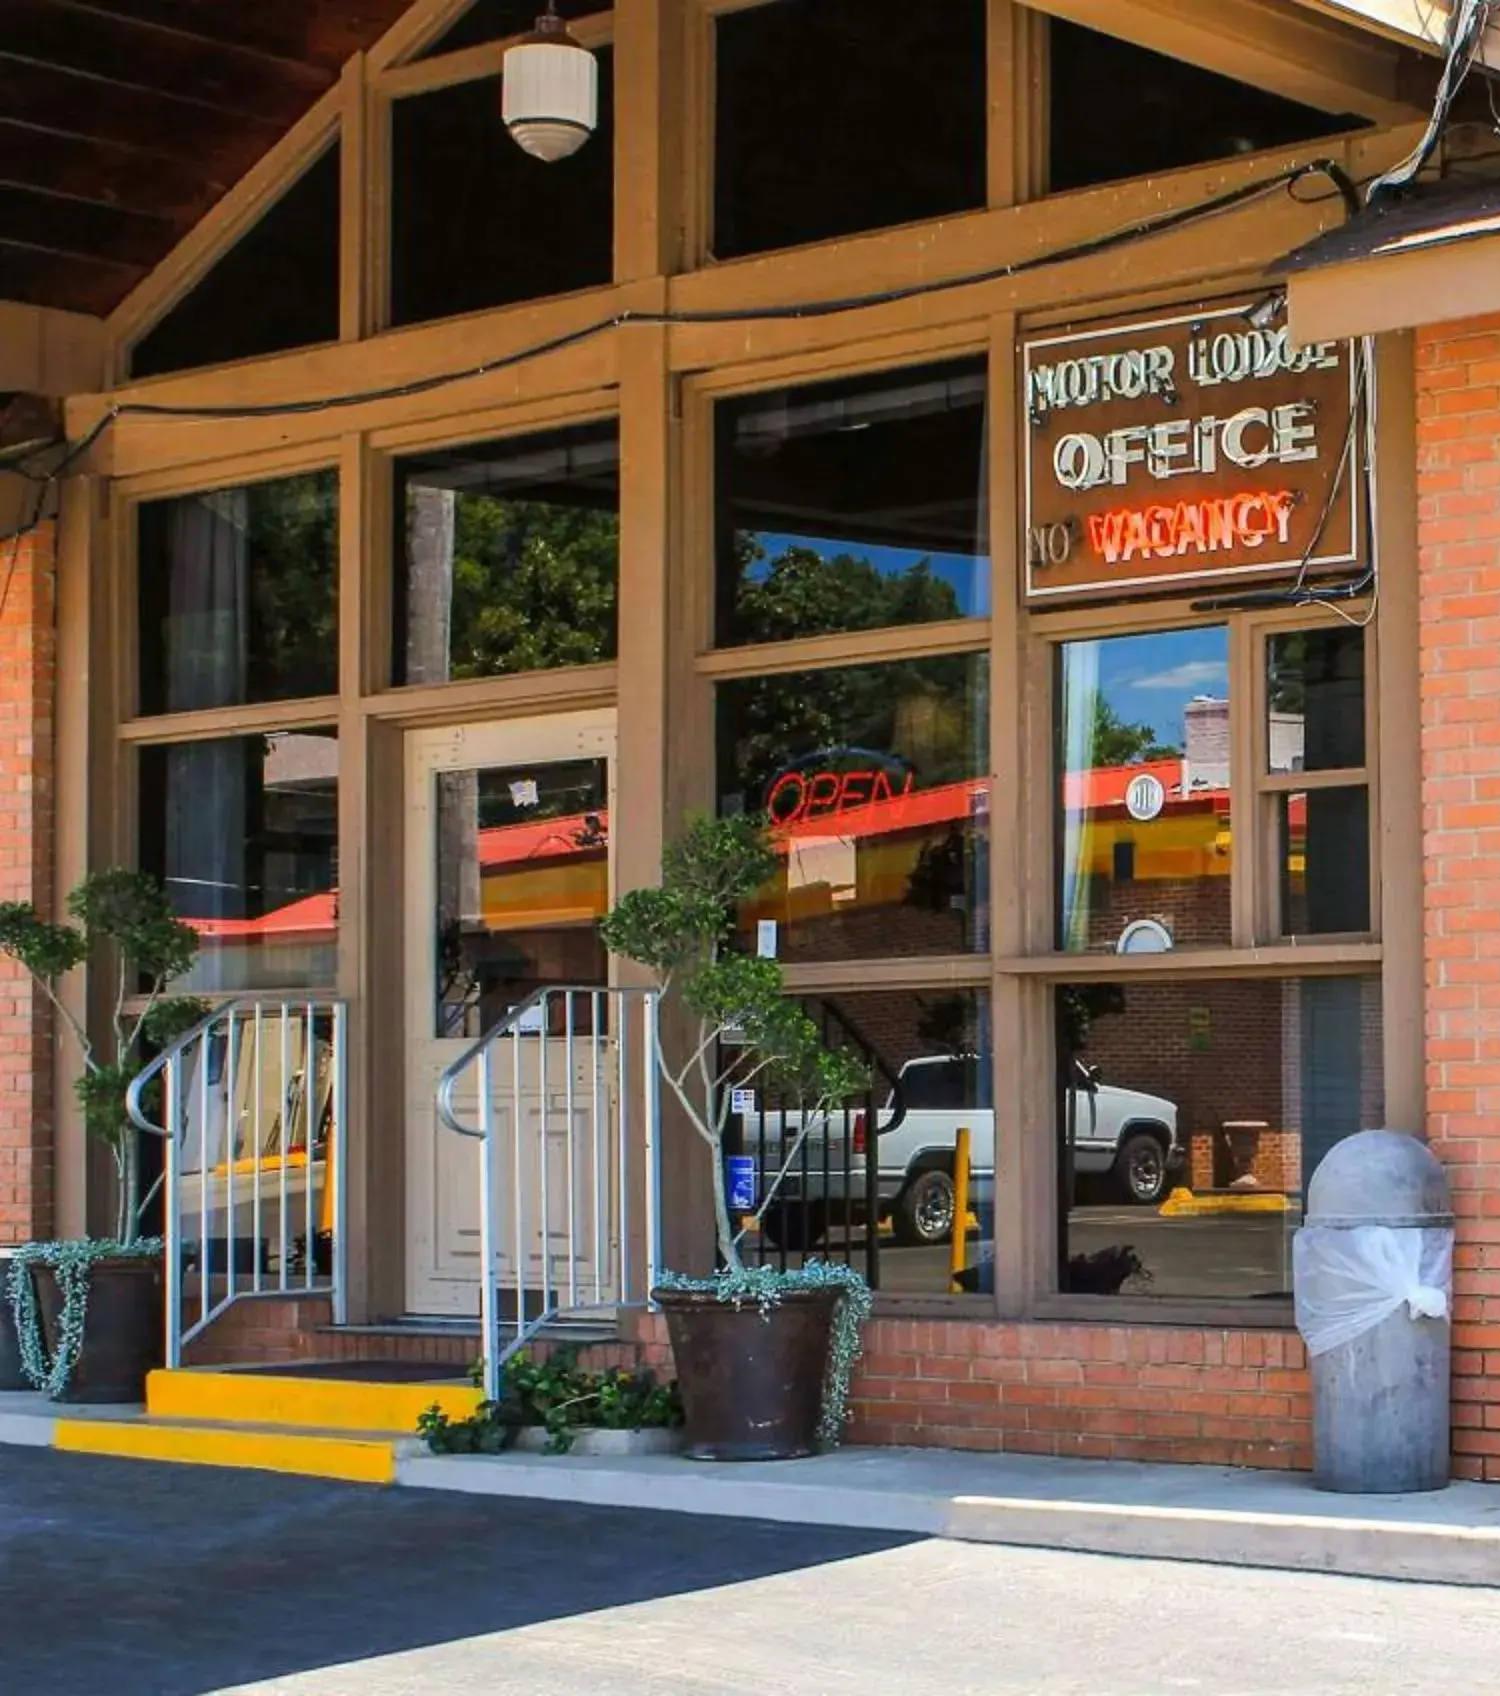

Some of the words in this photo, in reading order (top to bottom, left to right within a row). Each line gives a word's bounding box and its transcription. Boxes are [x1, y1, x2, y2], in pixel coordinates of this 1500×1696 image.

[1028, 346, 1174, 409] MOTOR
[1053, 403, 1318, 488] OFFICE
[1028, 522, 1071, 566] NO
[1087, 491, 1296, 563] VACANCY
[767, 771, 914, 825] OPEN
